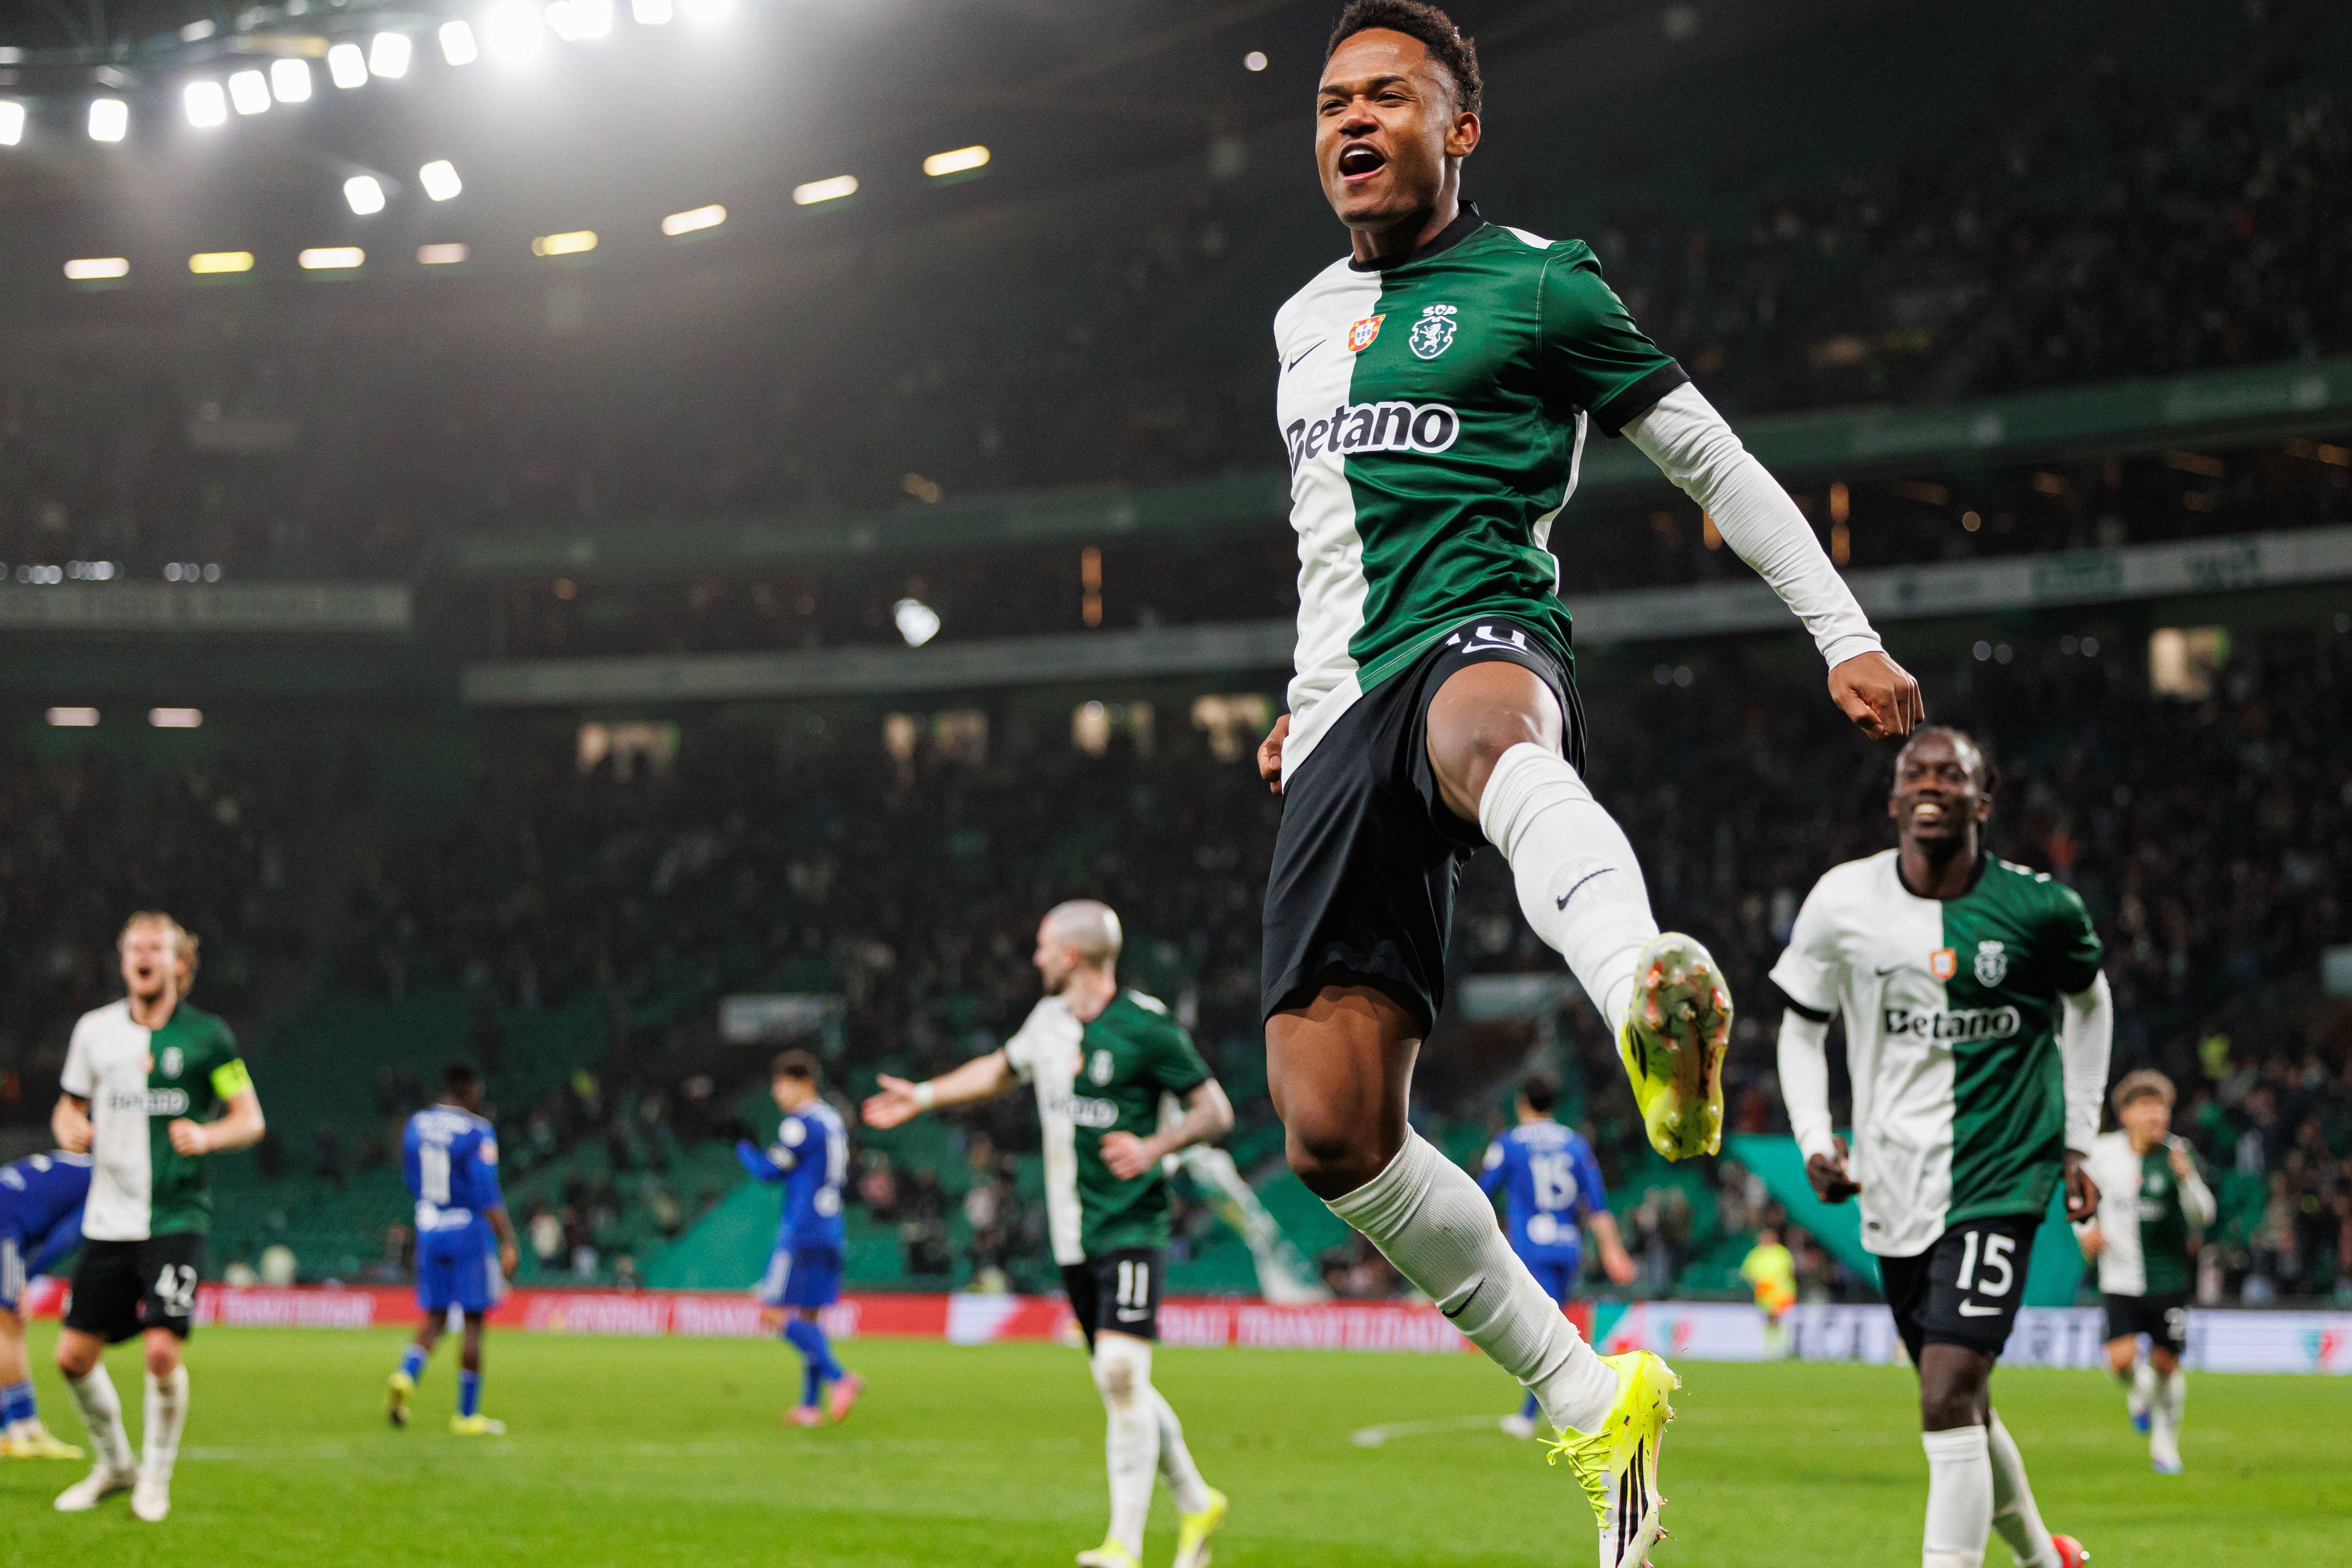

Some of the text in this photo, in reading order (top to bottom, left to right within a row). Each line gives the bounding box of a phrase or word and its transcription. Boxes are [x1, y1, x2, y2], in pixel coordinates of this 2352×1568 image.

[1422, 304, 1458, 317] SCP
[1286, 405, 1454, 477] Betano
[1884, 1008, 2015, 1039] Betano
[154, 1263, 197, 1308] 42
[1117, 1260, 1149, 1308] 11
[1955, 1230, 2016, 1297] 15
